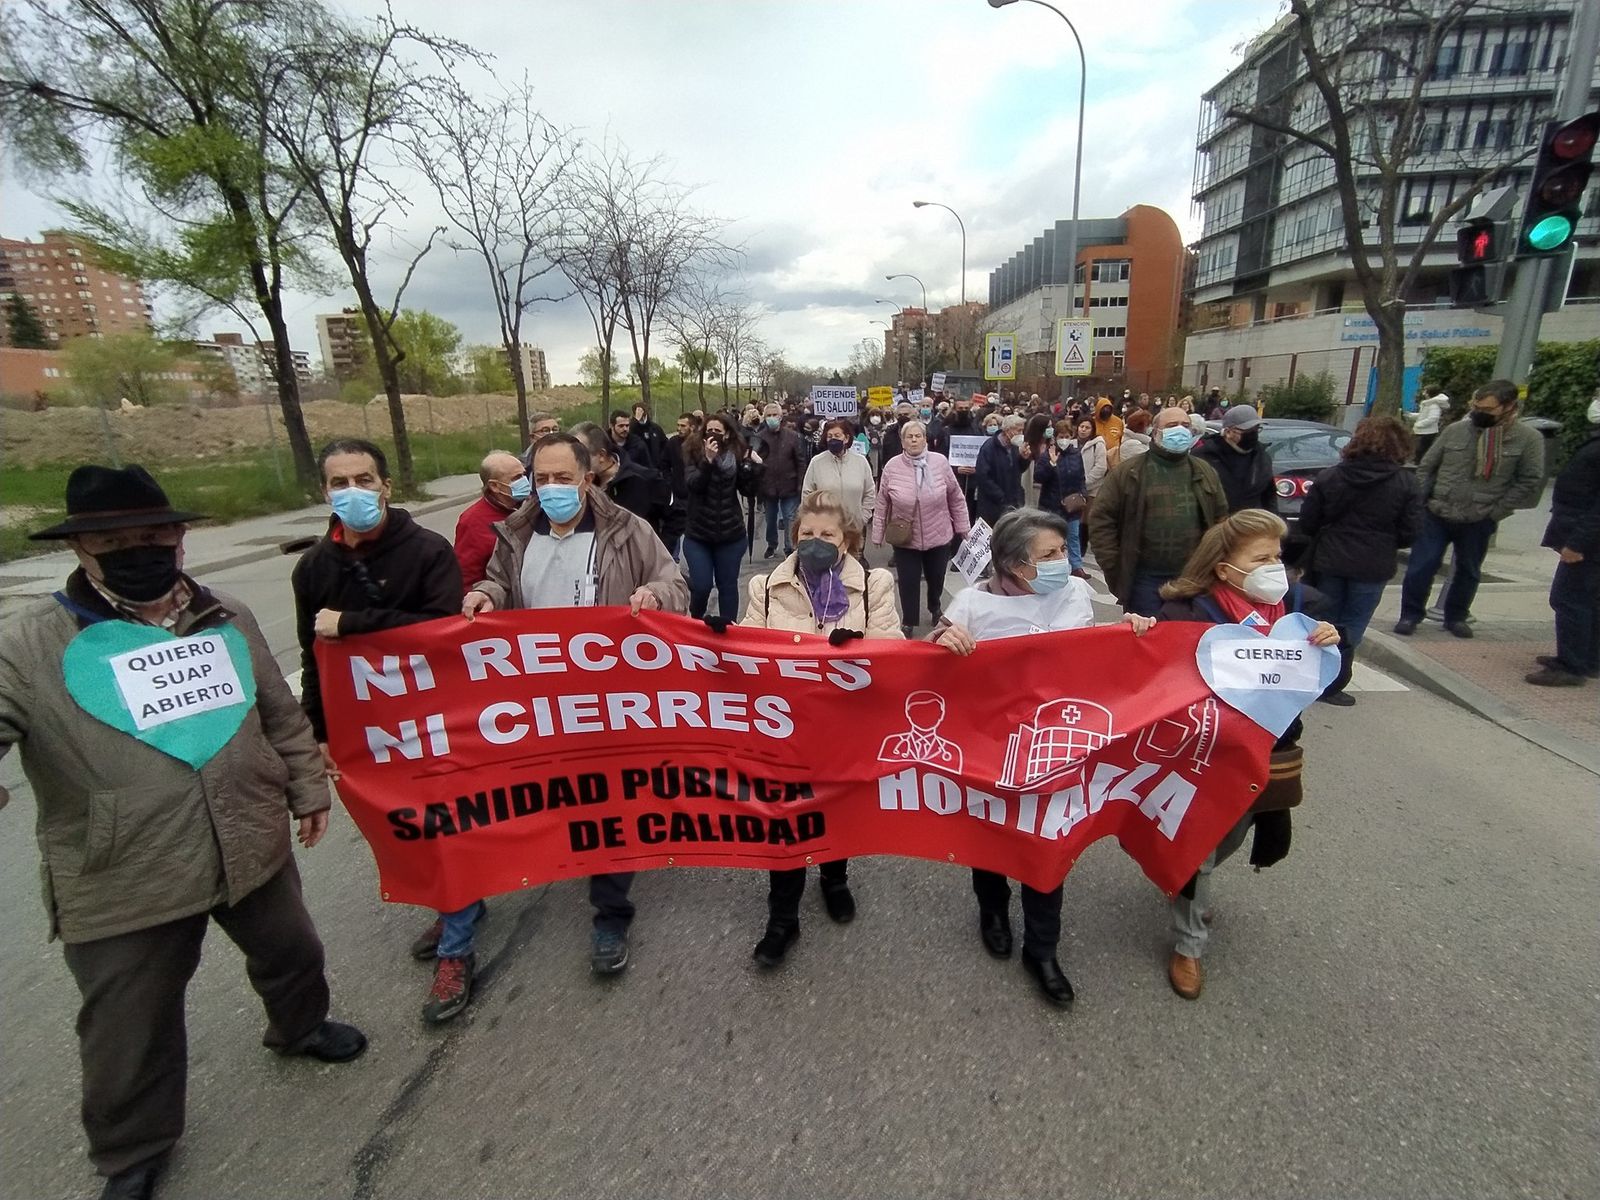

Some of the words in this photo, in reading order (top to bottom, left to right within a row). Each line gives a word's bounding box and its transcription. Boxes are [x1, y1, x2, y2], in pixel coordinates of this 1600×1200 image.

[815, 401, 826, 412] TU
[827, 401, 856, 413] SALUD!
[128, 640, 216, 673] QUIERO
[349, 654, 437, 702] NI
[460, 632, 873, 692] RECORTES
[1234, 648, 1303, 661] CIERRES
[151, 663, 213, 690] SUAP
[1261, 673, 1281, 685] NO
[141, 682, 234, 719] ABIERTO
[364, 712, 451, 764] NI
[478, 691, 795, 745] CIERRES
[386, 772, 609, 843] SANIDAD
[621, 760, 816, 803] PÚBLICA
[568, 816, 626, 852] DE
[636, 811, 826, 847] CALIDAD
